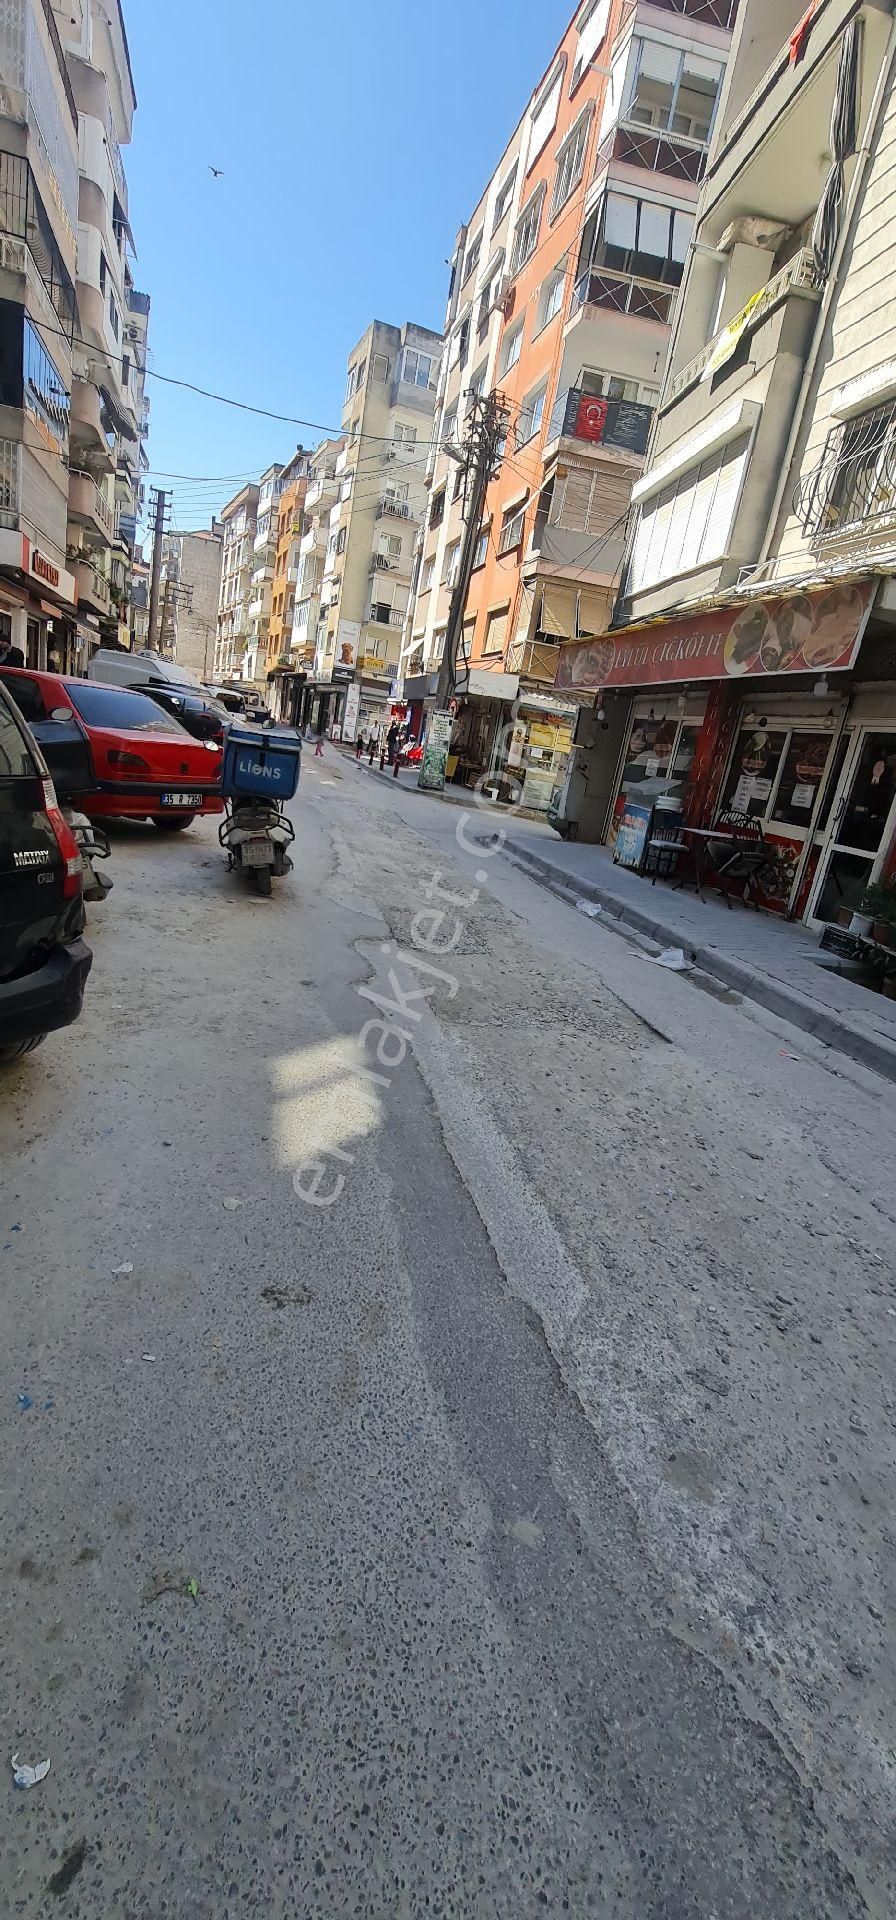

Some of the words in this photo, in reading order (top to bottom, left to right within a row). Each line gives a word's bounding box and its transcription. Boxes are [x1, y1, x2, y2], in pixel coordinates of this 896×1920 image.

[165, 794, 174, 805] 35
[178, 794, 184, 804] R
[13, 849, 50, 867] MATRIX
